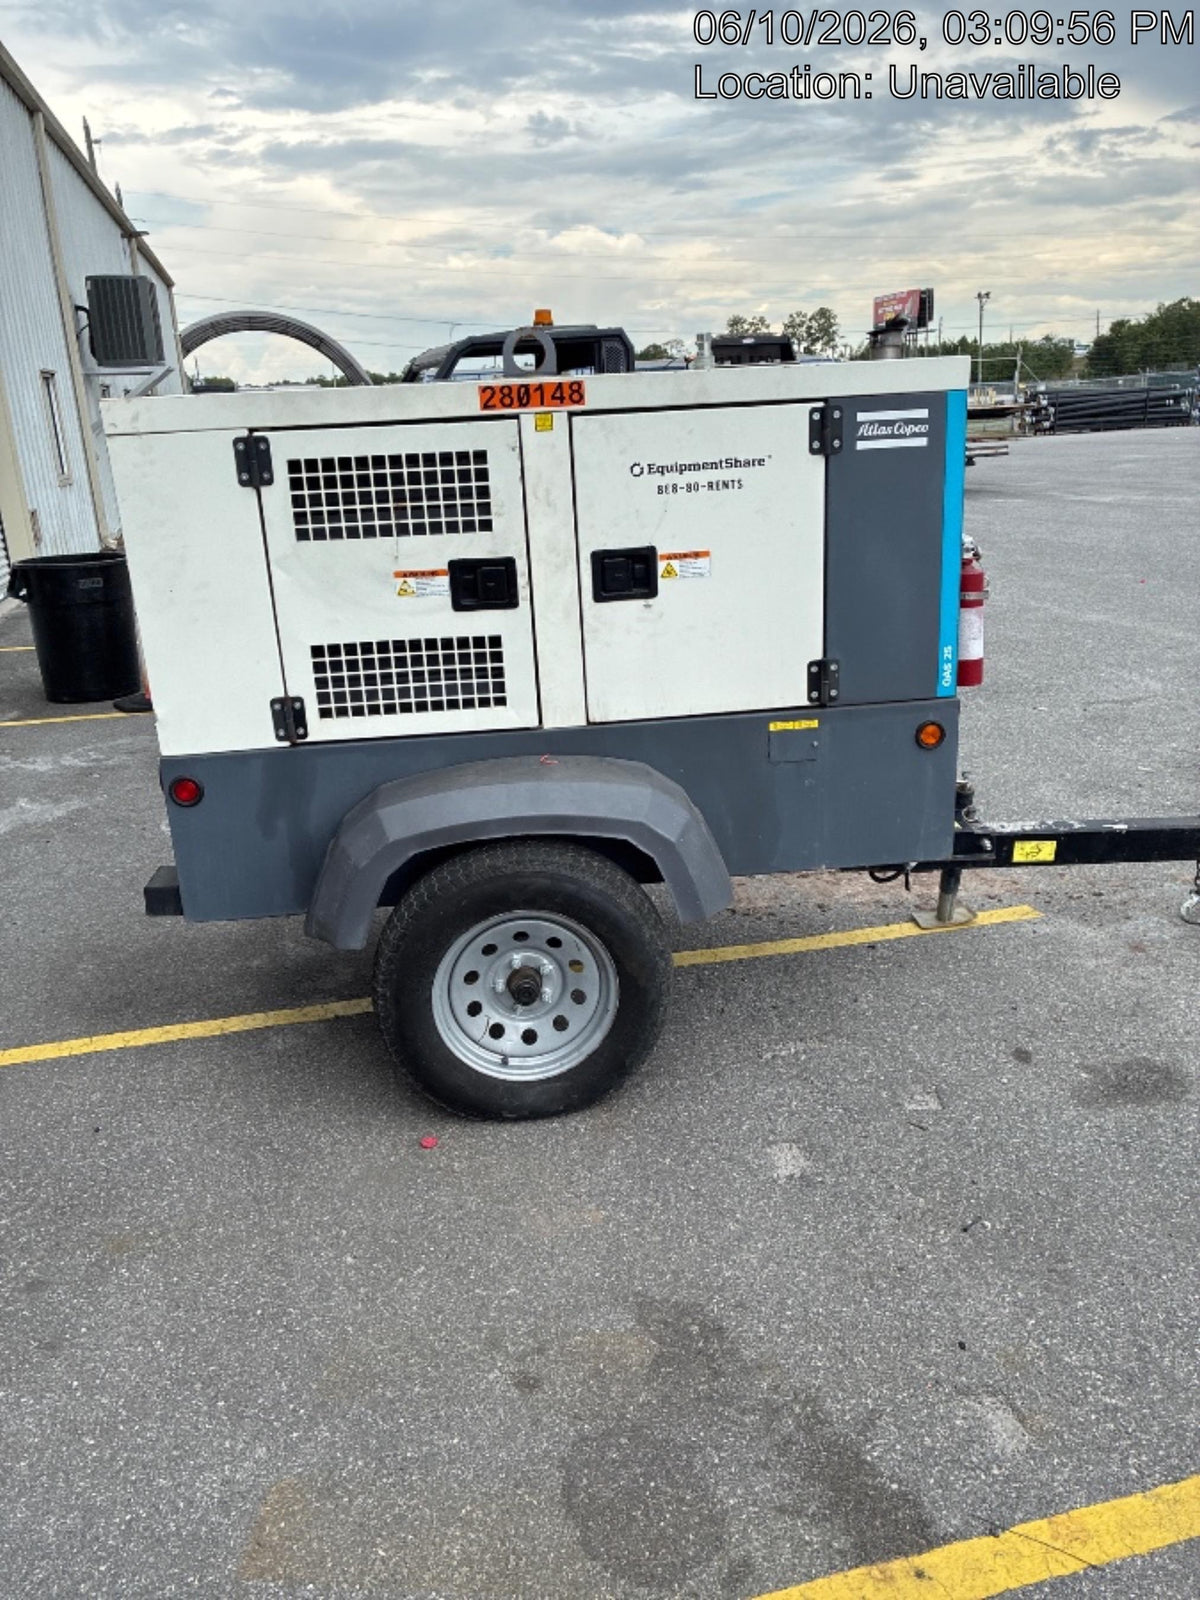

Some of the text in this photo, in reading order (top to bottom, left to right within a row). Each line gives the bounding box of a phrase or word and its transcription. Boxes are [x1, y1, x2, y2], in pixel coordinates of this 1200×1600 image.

[481, 381, 584, 409] 280148
[857, 421, 929, 436] Atlas Copco
[647, 457, 766, 475] EquipmentShare
